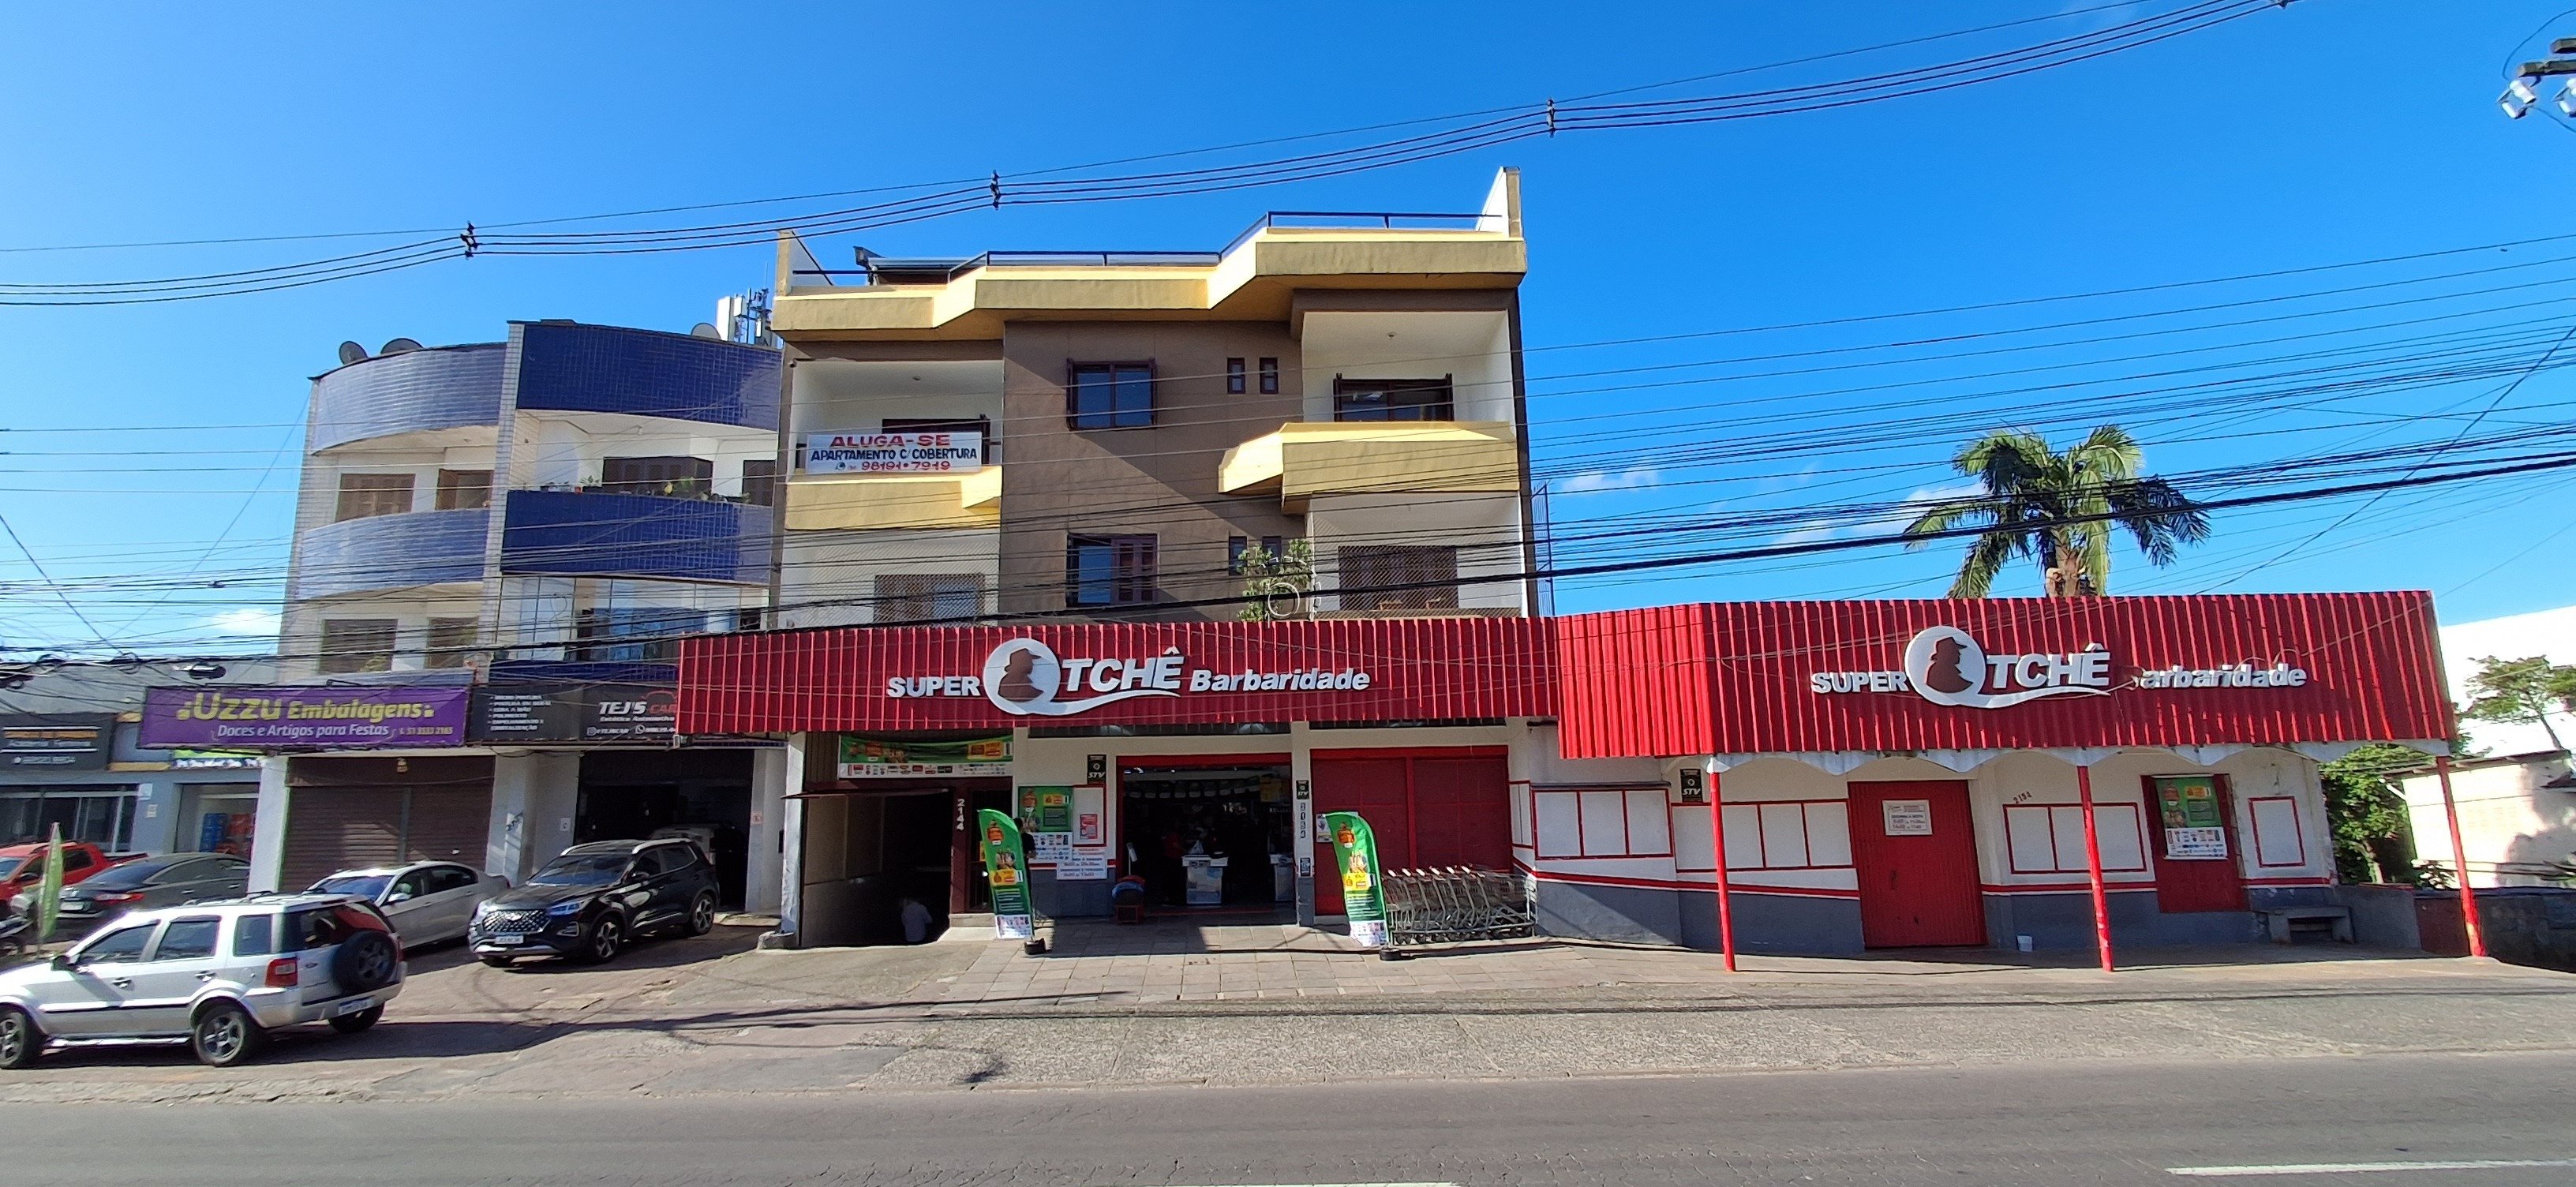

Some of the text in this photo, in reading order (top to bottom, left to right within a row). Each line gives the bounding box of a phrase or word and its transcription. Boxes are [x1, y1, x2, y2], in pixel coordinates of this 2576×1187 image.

[829, 435, 950, 447] ALUGA-SE
[811, 449, 897, 461] APARTAMENTO
[887, 676, 981, 697] SUPER
[1189, 668, 1370, 692] Barbaridade
[1811, 670, 1910, 694] SUPER
[287, 699, 424, 723] Embalagens
[599, 702, 647, 714] TEJ'S
[218, 724, 389, 739] Doces e Artigos para Festas
